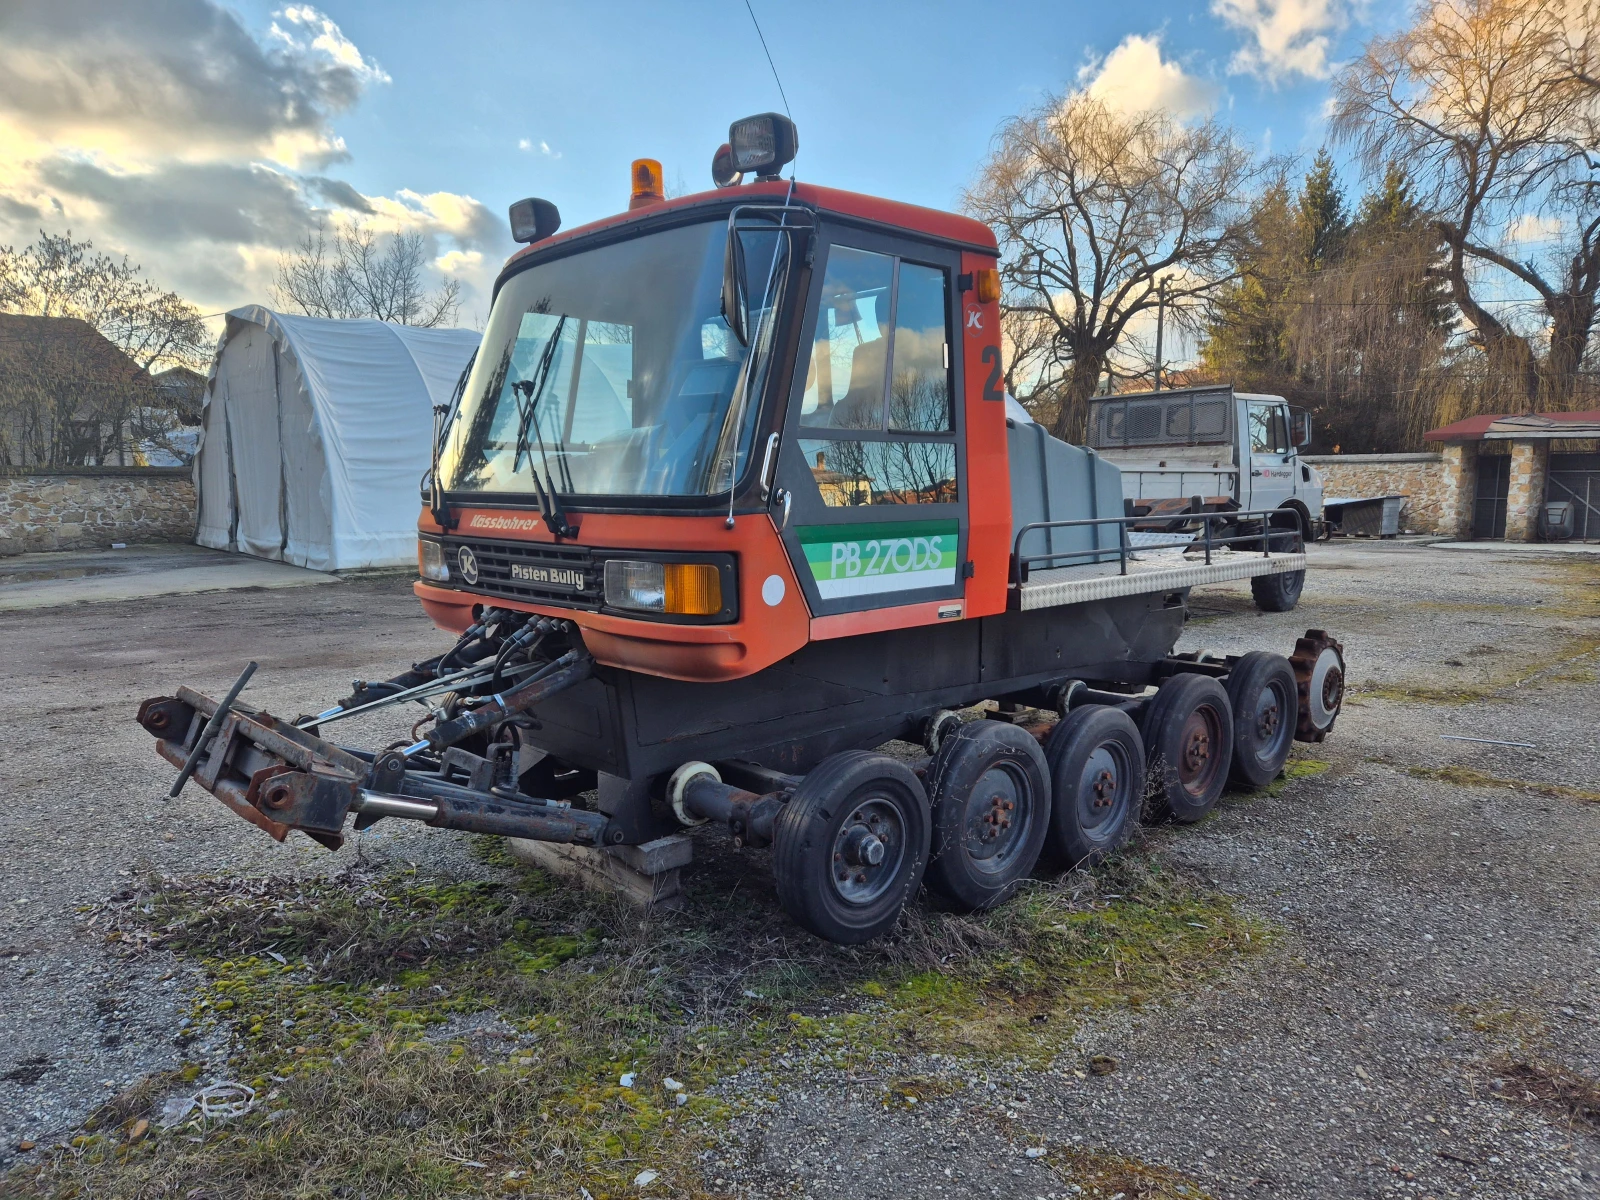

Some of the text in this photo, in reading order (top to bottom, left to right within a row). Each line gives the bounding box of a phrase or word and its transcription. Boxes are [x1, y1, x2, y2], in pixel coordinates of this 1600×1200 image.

[982, 345, 1004, 401] 2
[469, 514, 539, 531] Kässbohrer
[511, 563, 584, 591] Pisten Bully
